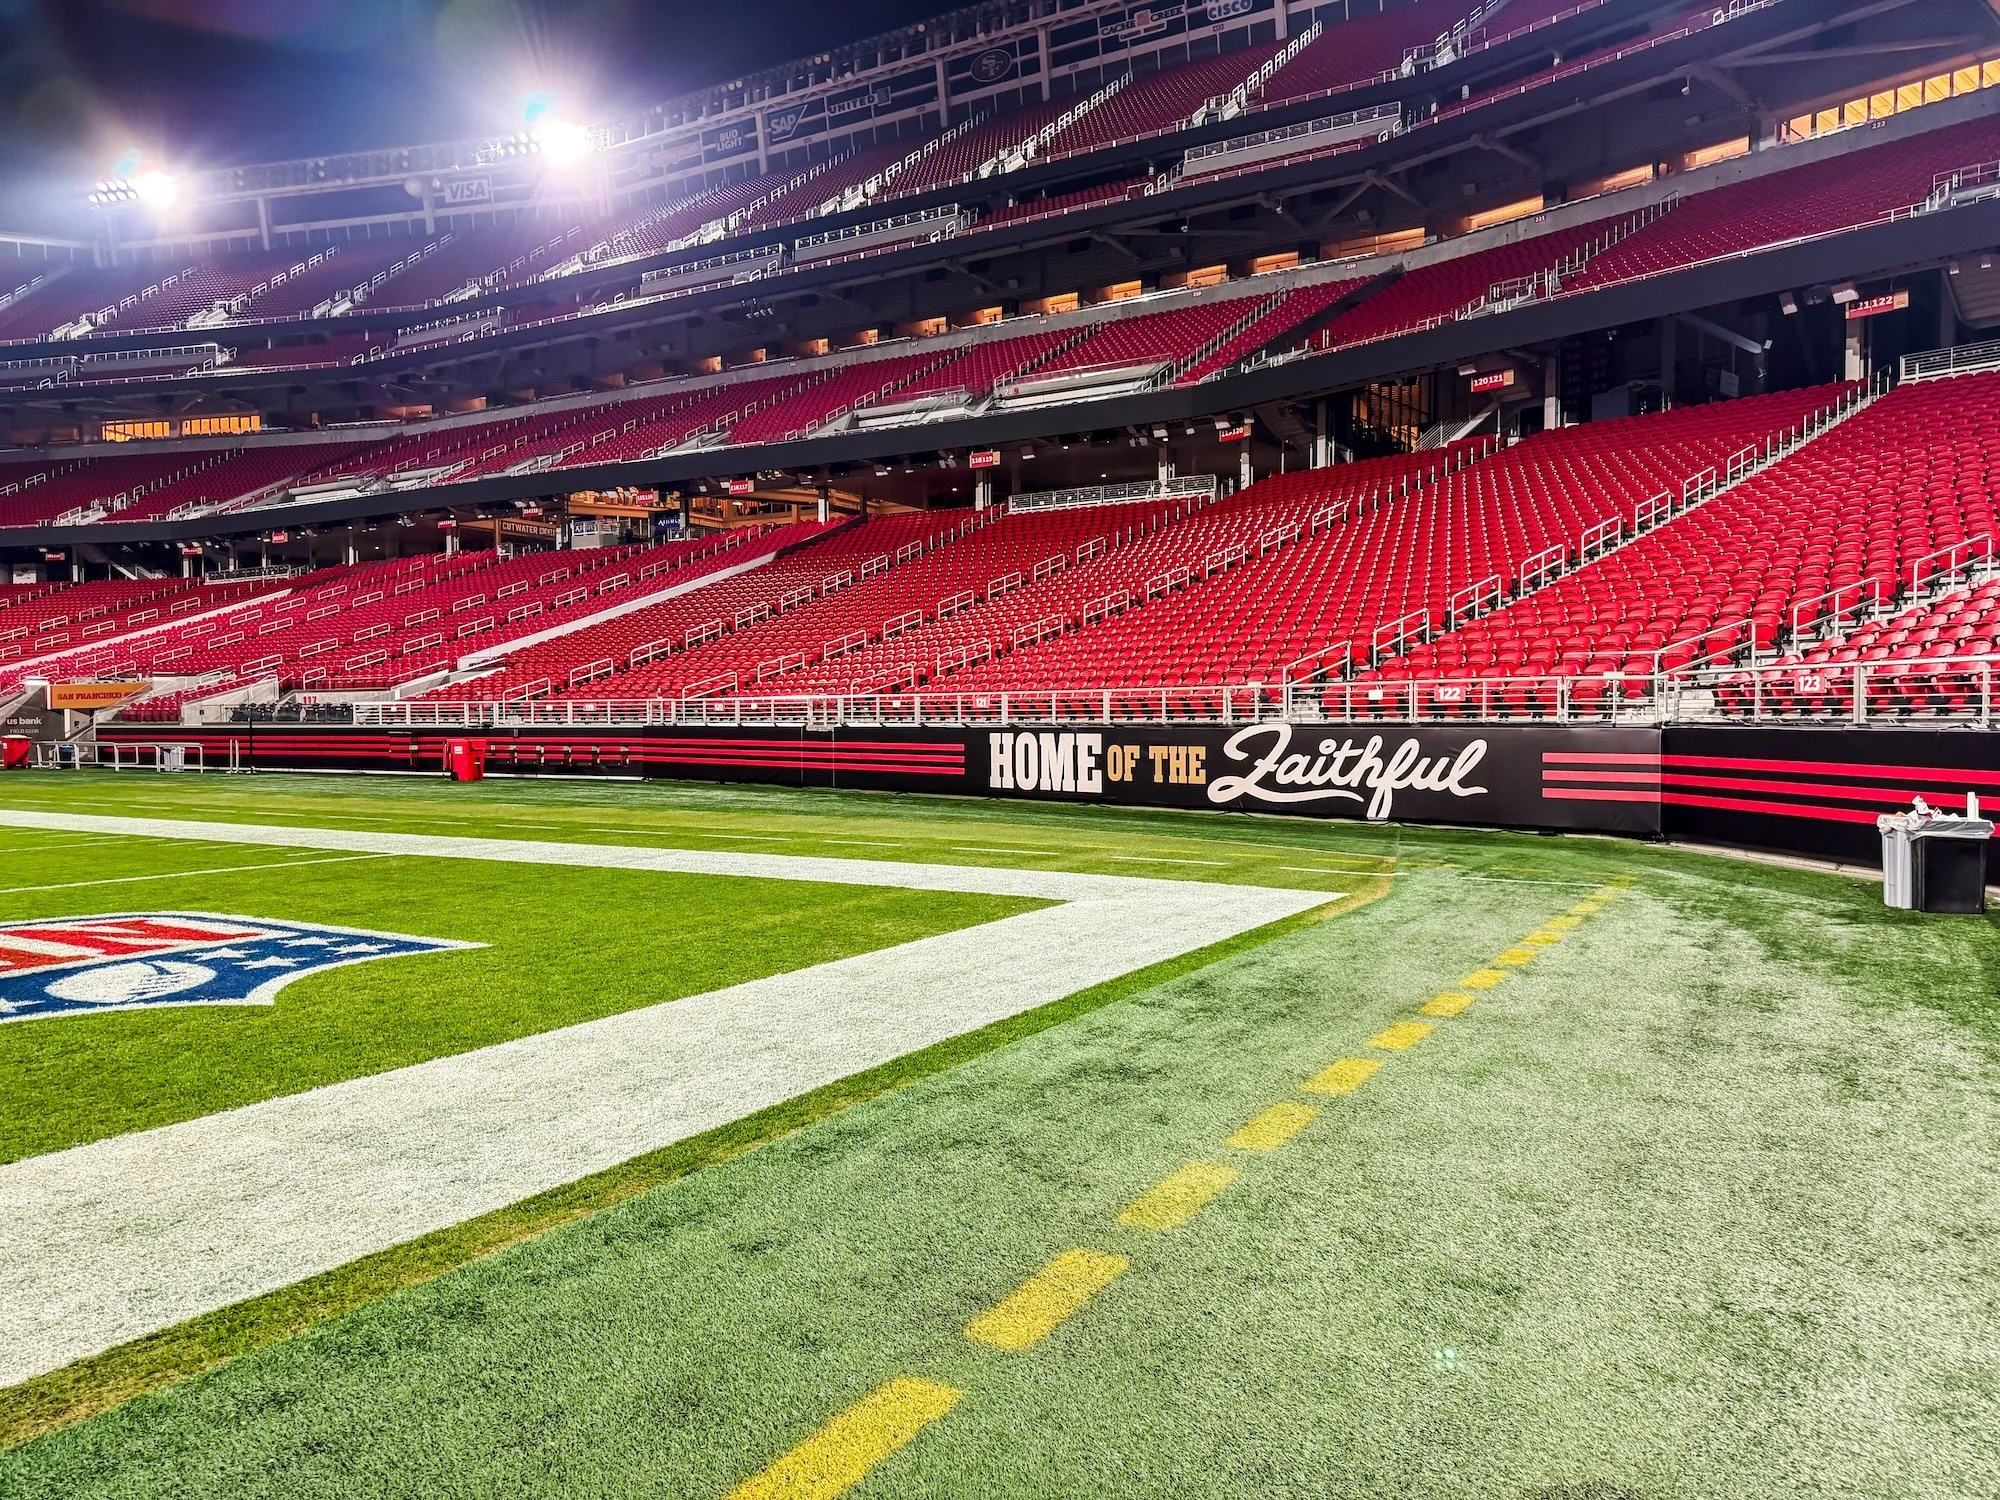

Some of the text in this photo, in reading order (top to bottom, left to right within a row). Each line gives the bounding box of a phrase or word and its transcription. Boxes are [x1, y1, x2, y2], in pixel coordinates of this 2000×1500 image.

[1208, 0, 1251, 18] CISCO
[1101, 6, 1184, 36] CACHE CREEK
[829, 96, 875, 114] UNITED
[770, 114, 797, 135] SAP
[1872, 121, 1885, 129] 222
[719, 129, 739, 141] BUD
[716, 136, 743, 152] LIGHT
[447, 183, 487, 200] VISA
[1850, 295, 1893, 311] 21 122
[1473, 374, 1504, 387] 120 121
[502, 521, 538, 535] CUTWATER
[1798, 675, 1821, 691] 123
[76, 691, 122, 700] FRANCISCO
[1438, 687, 1461, 700] 122
[19, 717, 42, 725] bank
[989, 723, 1489, 819] HOME OF THE Faithful
